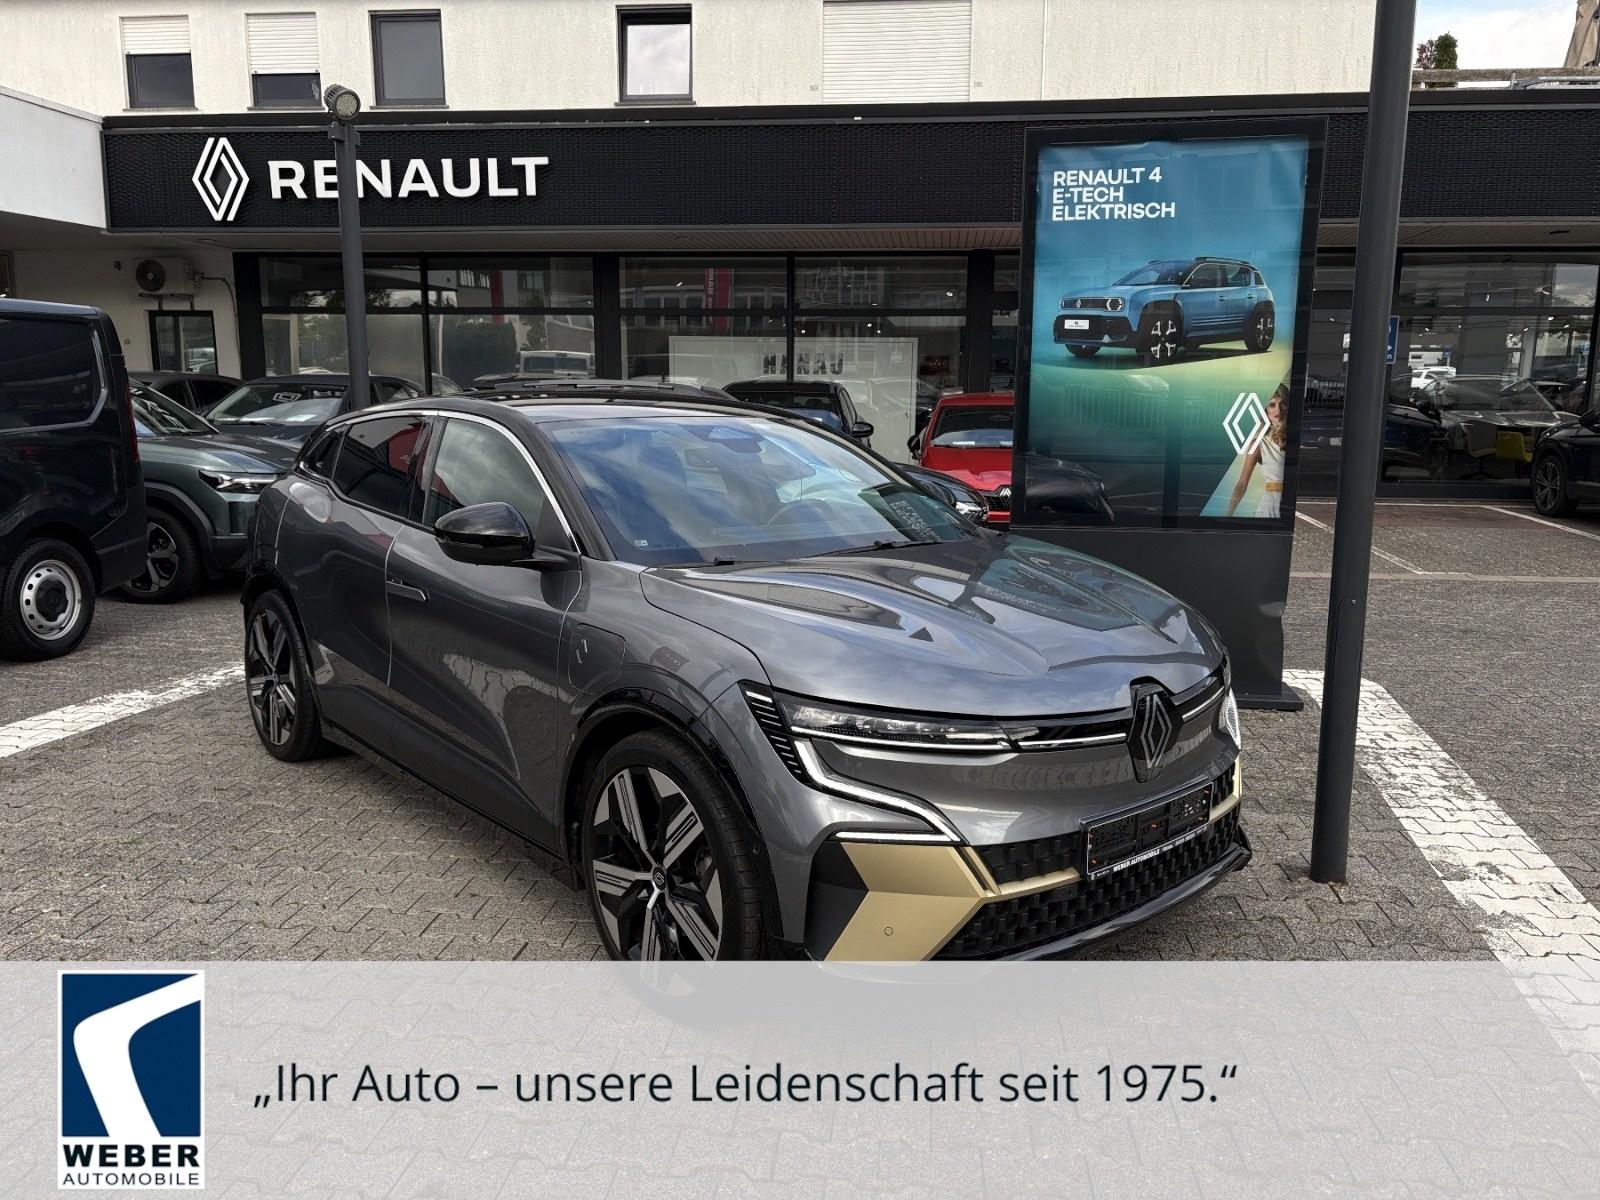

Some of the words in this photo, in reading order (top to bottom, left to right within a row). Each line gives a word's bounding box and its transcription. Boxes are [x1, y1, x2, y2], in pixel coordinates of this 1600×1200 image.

[267, 156, 549, 199] RENAULT
[1053, 167, 1146, 187] RENAULT
[1148, 166, 1163, 183] 4
[1052, 186, 1124, 204] E-TECH
[1052, 202, 1176, 221] ELEKTRISCH
